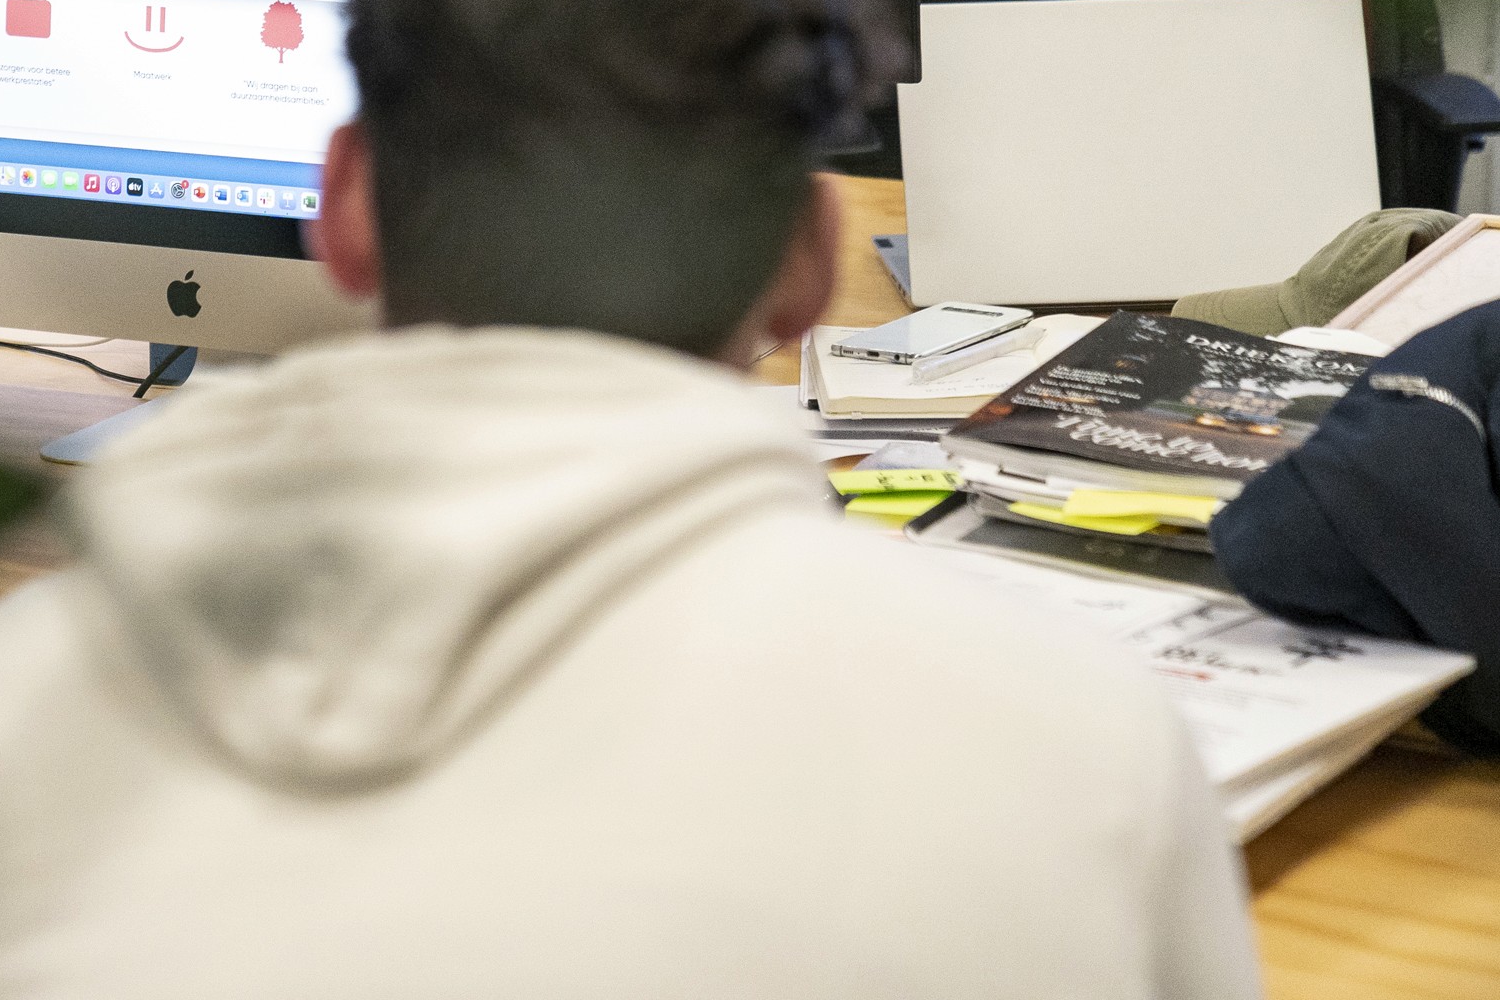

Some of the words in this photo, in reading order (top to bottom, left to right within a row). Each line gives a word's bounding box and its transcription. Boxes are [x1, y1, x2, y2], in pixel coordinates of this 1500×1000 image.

[0, 64, 25, 75] zorgen
[27, 66, 44, 75] voor
[45, 67, 71, 77] betere
[260, 81, 288, 93] dragen
[290, 83, 301, 95] bij
[302, 85, 318, 94] aan
